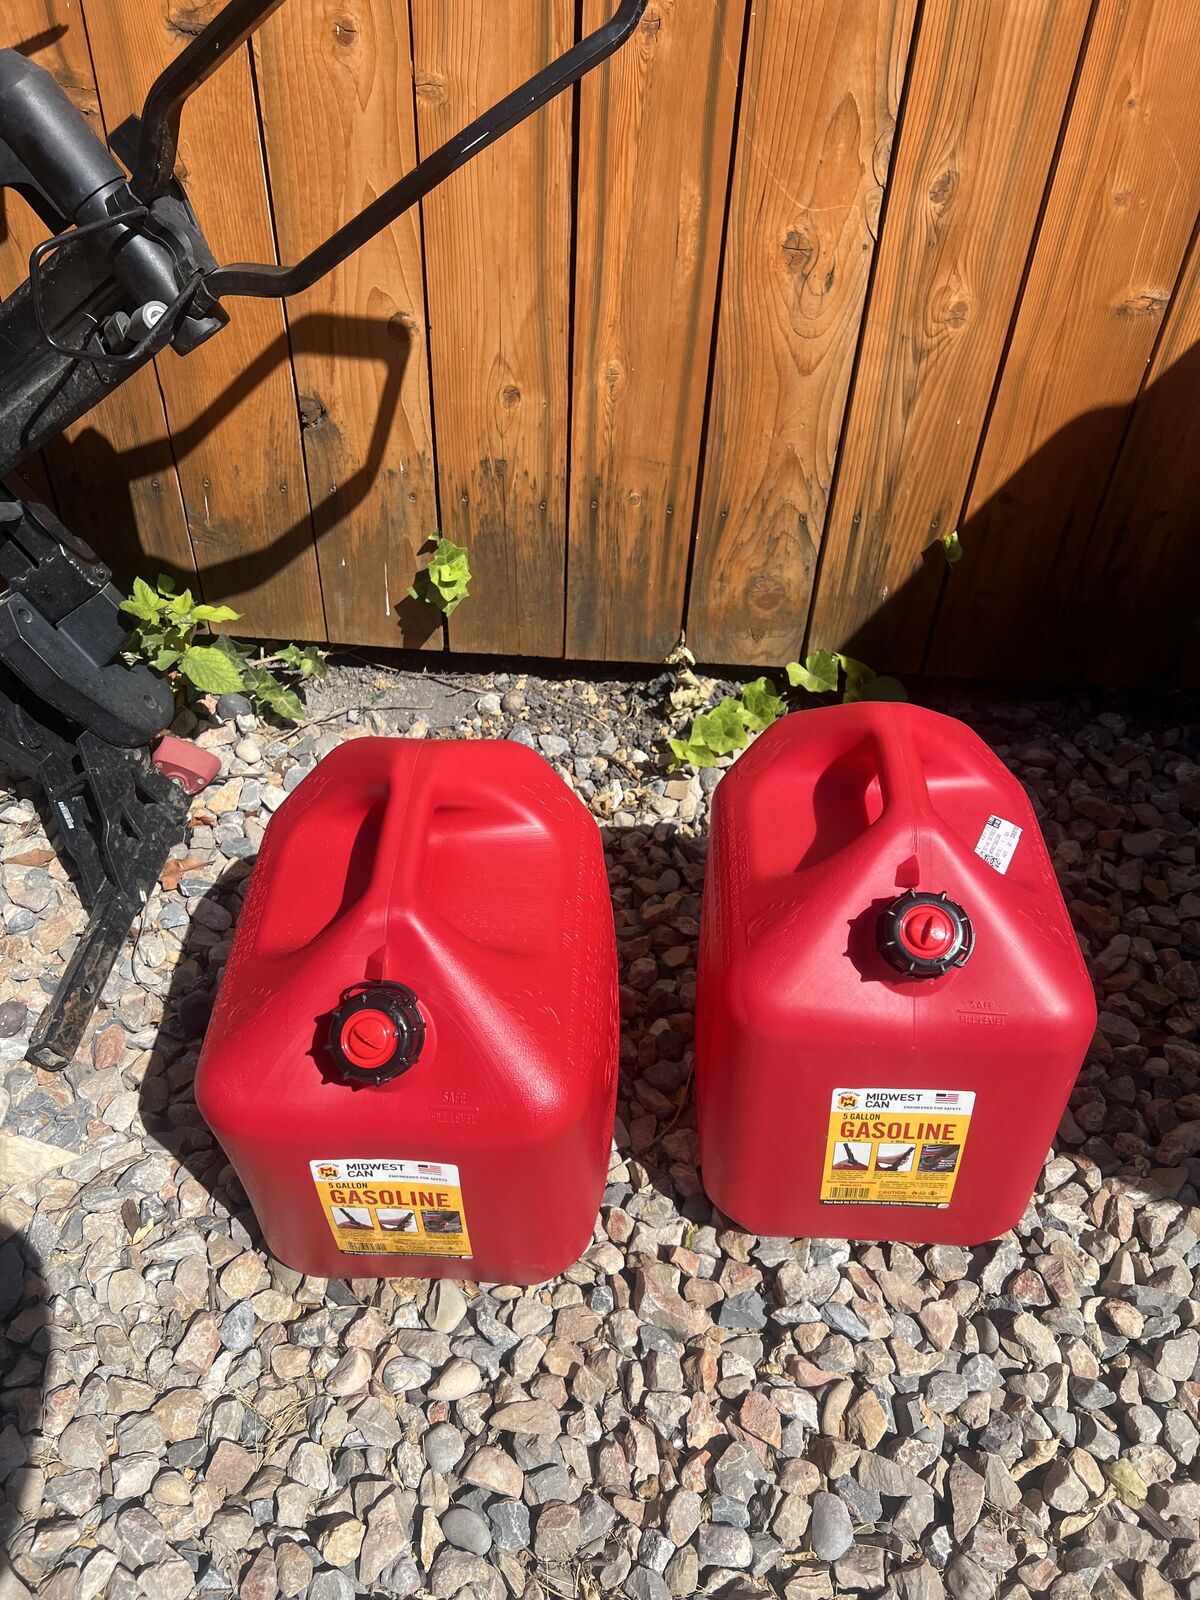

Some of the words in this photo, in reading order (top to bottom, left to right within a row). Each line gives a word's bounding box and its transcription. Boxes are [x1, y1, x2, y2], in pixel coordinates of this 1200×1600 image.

[442, 1090, 467, 1104] SAFE
[866, 1093, 923, 1102] MIDWEST
[865, 1101, 890, 1109] CAN
[850, 1113, 881, 1121] GALLON
[841, 1122, 957, 1140] GASOLINE
[346, 1163, 405, 1171] MIDWEST
[347, 1170, 374, 1178] CAN
[330, 1190, 450, 1207] GASOLINE
